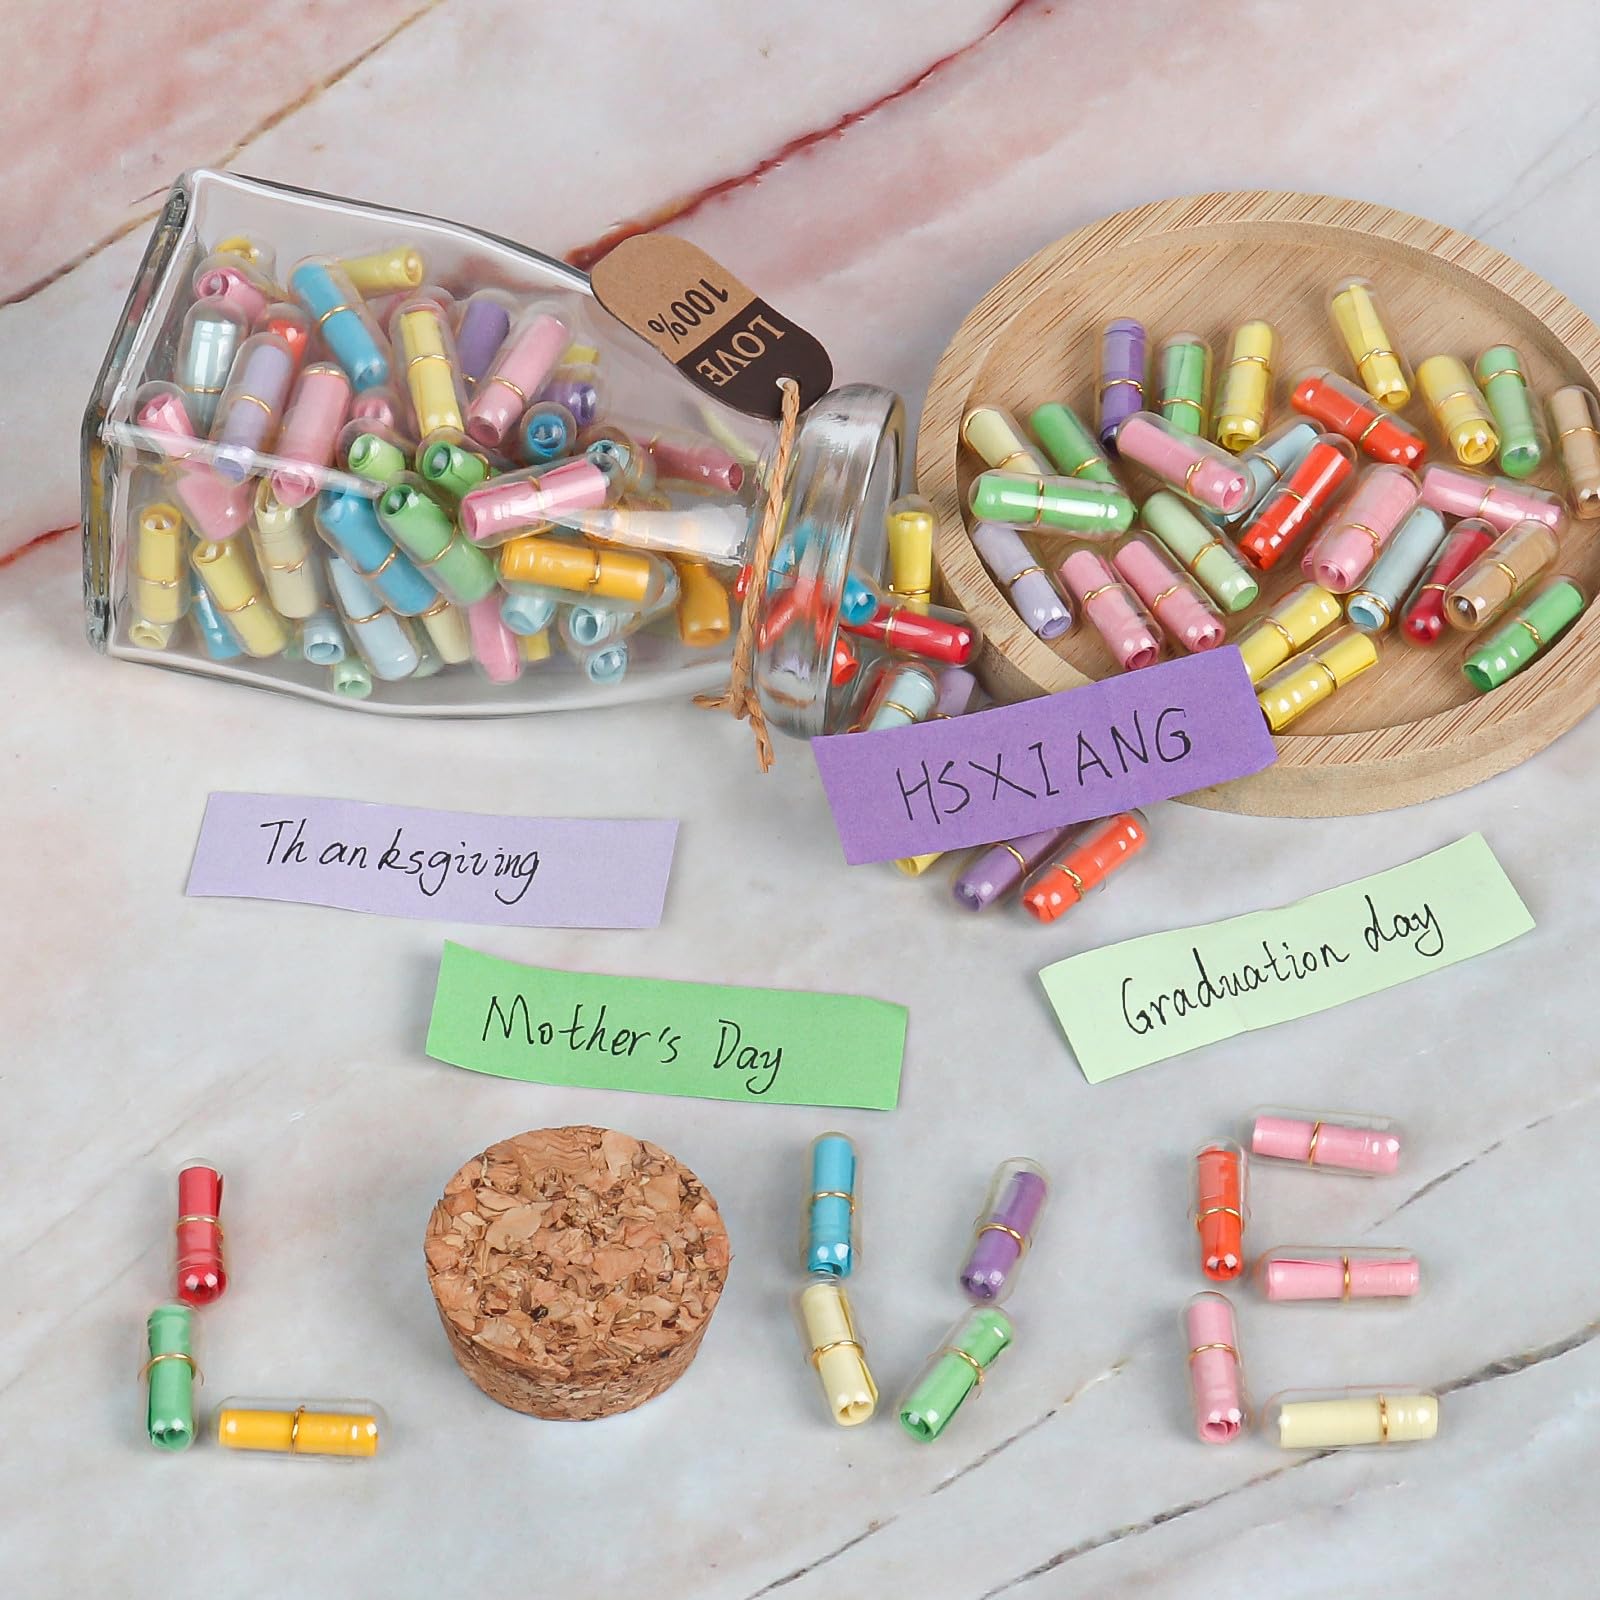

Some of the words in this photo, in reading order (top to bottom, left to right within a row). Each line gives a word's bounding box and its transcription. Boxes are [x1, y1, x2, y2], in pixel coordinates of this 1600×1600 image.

[647, 278, 729, 344] 100%
[695, 314, 786, 387] LOVE
[896, 707, 1192, 825] HSXIANG
[260, 818, 540, 905] Thanksgiving
[1121, 941, 1350, 1035] Graduation
[1363, 894, 1444, 957] day
[481, 994, 681, 1064] Mother's
[712, 1019, 783, 1095] Day
